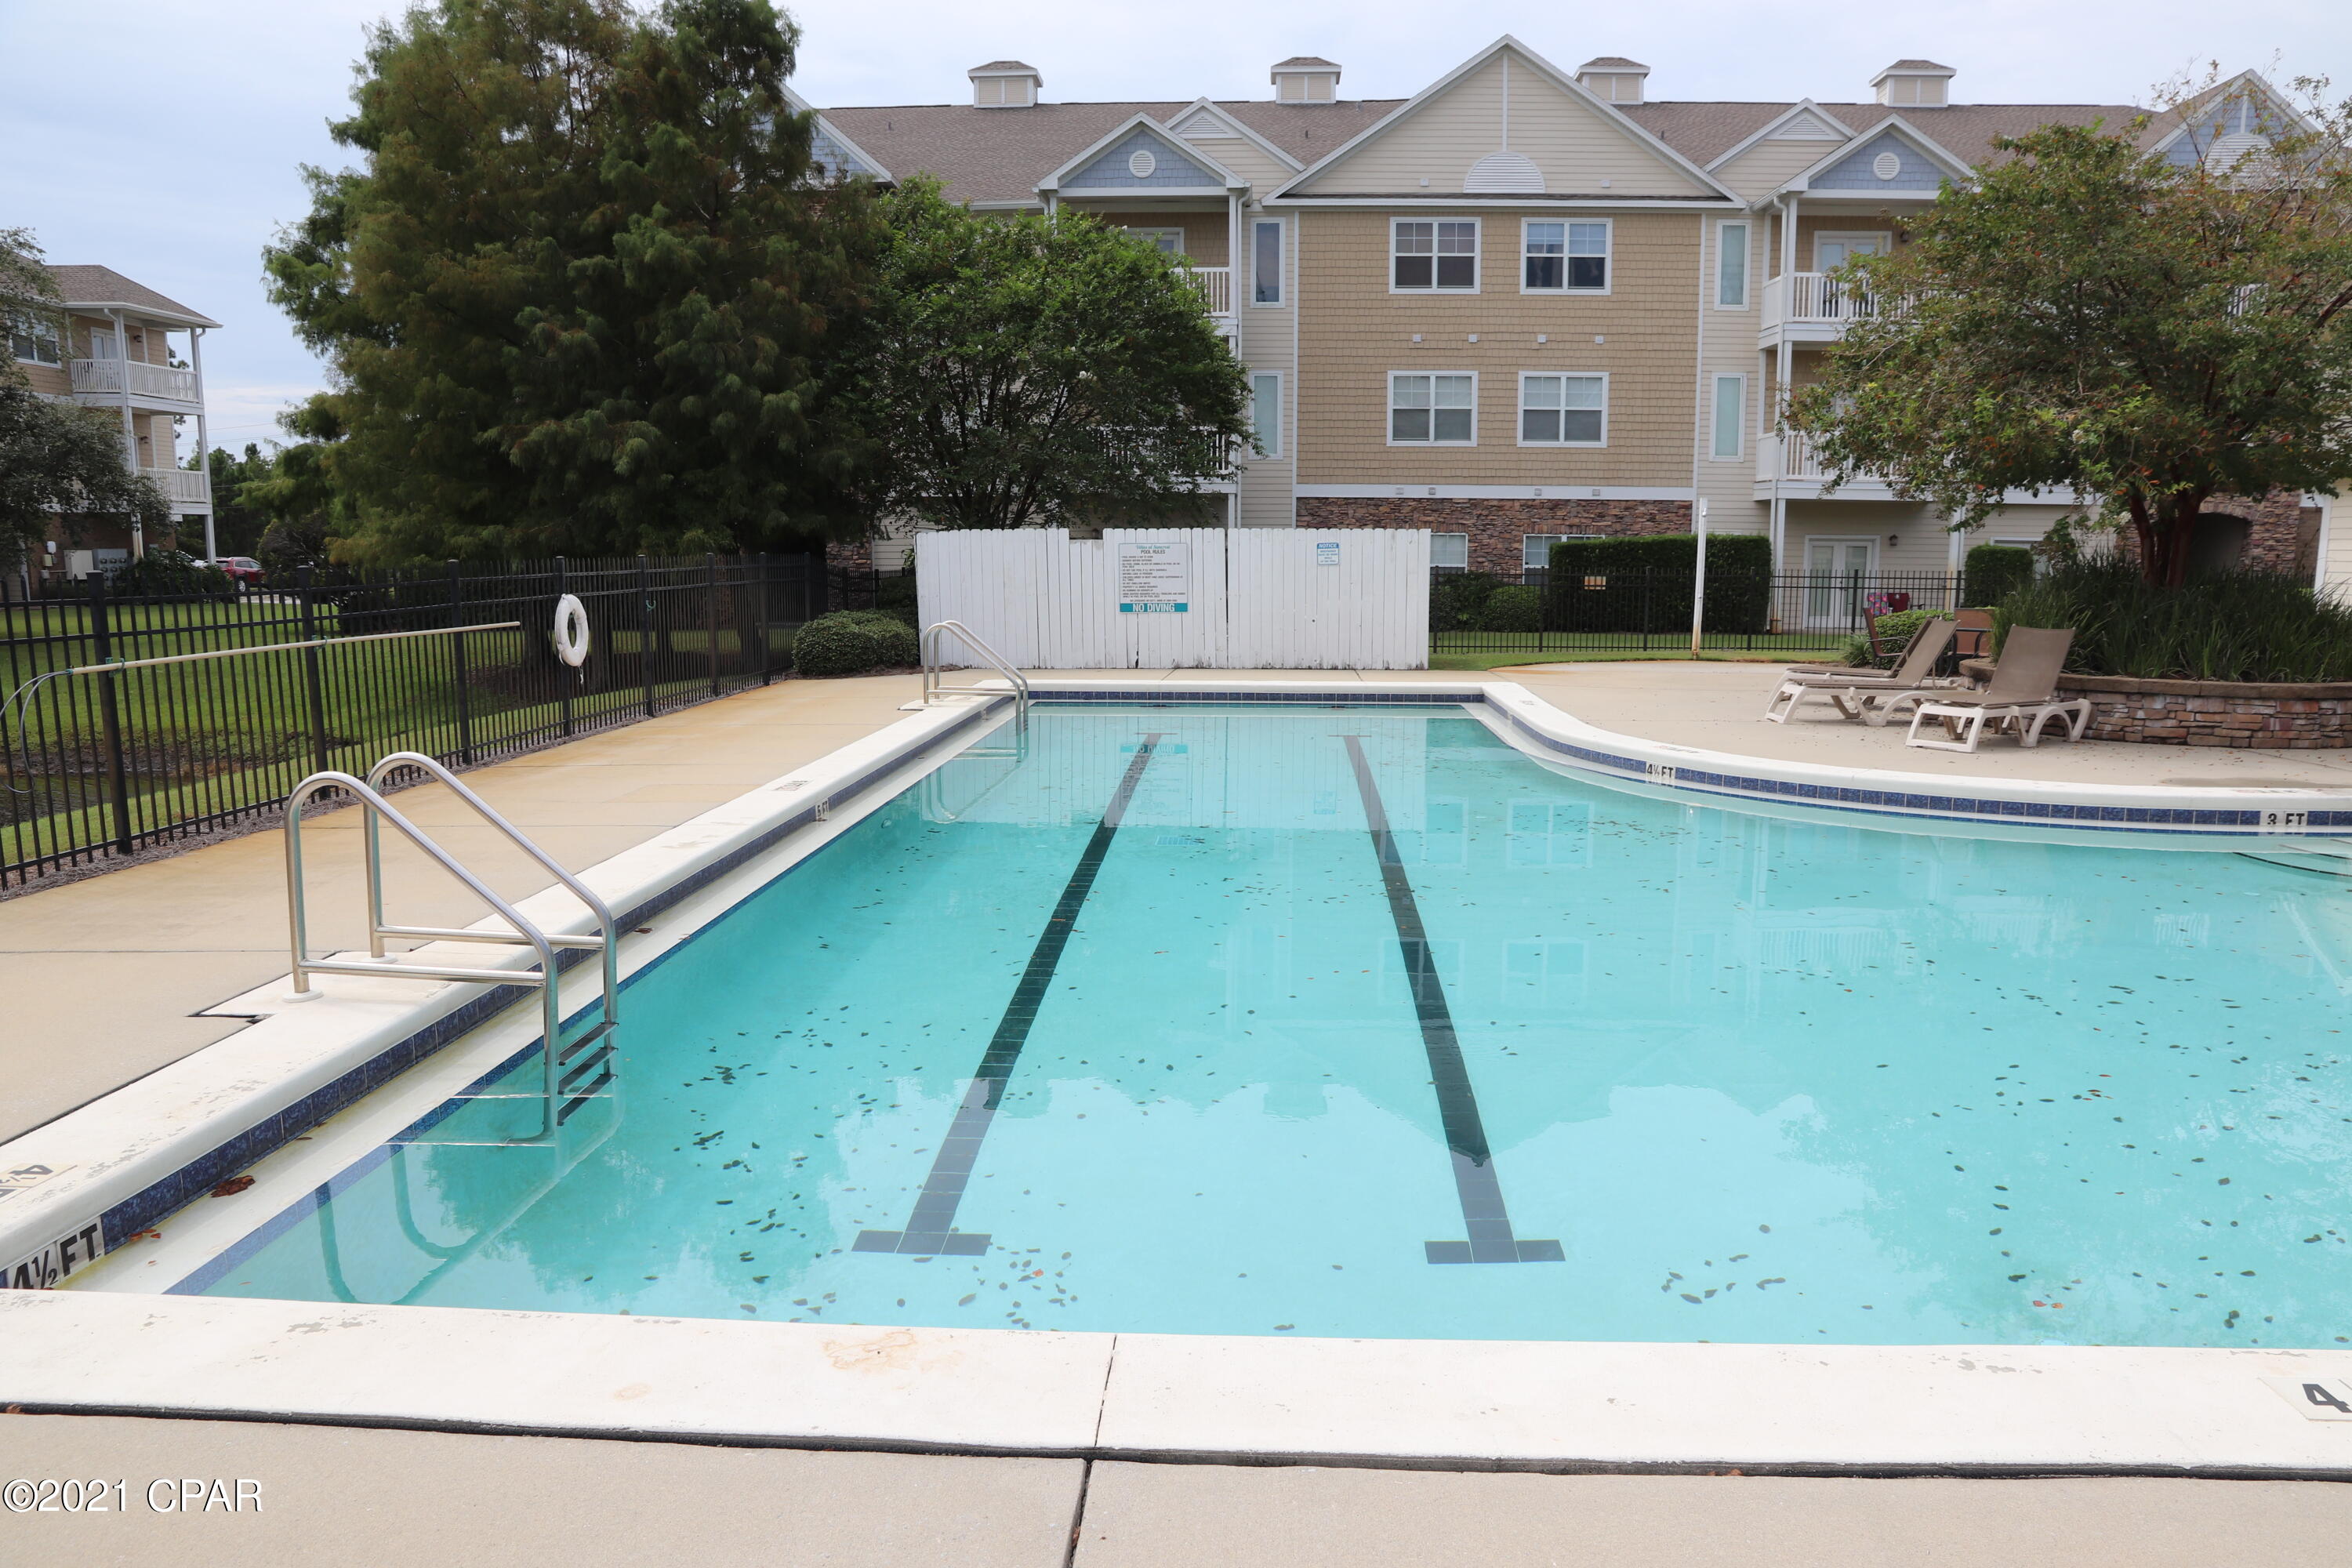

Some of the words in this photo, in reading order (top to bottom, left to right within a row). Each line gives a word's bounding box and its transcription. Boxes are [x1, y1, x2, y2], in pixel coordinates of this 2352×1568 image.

[1133, 603, 1145, 612] NO
[1147, 603, 1175, 612] DIVING
[1661, 766, 1674, 778] FT
[2267, 813, 2278, 825] 3
[2285, 813, 2305, 825] FT
[2302, 1383, 2352, 1414] 4
